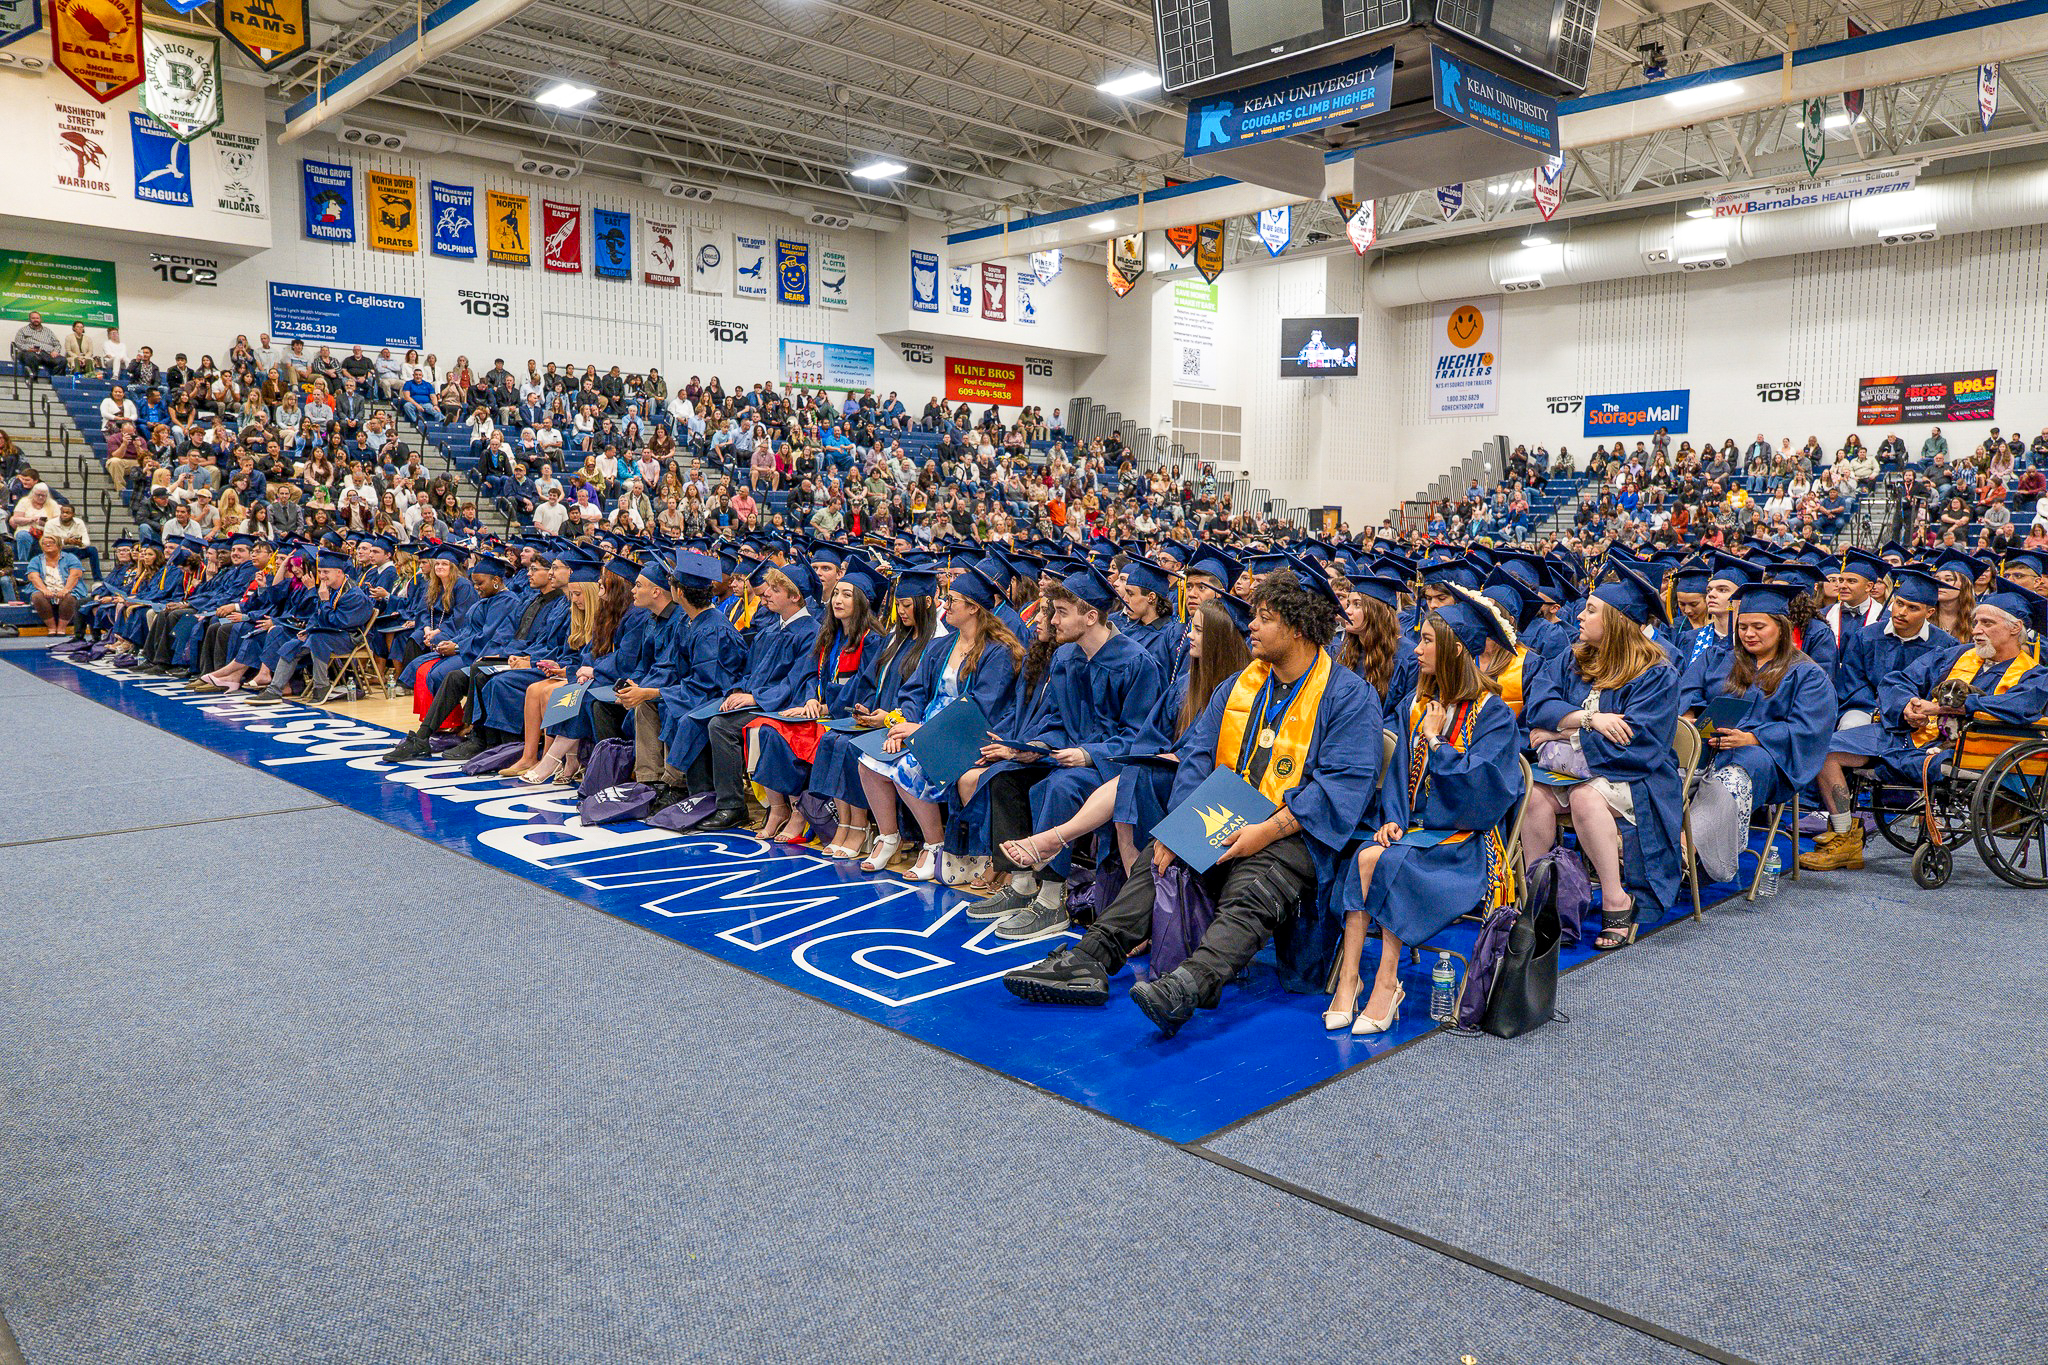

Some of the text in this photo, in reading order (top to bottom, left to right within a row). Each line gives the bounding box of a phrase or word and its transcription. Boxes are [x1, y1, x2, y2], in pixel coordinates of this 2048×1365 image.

[230, 11, 297, 35] RAMS
[62, 42, 135, 64] EAGLES
[73, 68, 128, 82] CONFERENCE
[86, 63, 114, 73] SHORE
[147, 44, 214, 98] RARITAN HIGH SCHOOL
[166, 59, 196, 91] R
[1242, 65, 1379, 114] KEAN UNIVERSITY
[1466, 77, 1549, 122] KEAN UNIVERSITY
[55, 103, 106, 120] WASHINGTON
[1241, 87, 1376, 131] COUGARS CLIMB HIGHER
[67, 114, 96, 127] STREET
[1467, 98, 1501, 122] COUGARS
[1501, 113, 1523, 131] CLIMB
[1523, 121, 1551, 140] HIGHER
[58, 122, 104, 136] ELEMENTARY
[211, 130, 260, 146] WALNUT STREET
[216, 140, 255, 151] ELEMENTARY
[305, 164, 351, 179] CEDAR GROVE
[57, 174, 111, 192] WARRIORS
[313, 175, 346, 187] ELEMENTARY
[371, 174, 414, 189] NORTH DOVER
[1774, 186, 1796, 195] TOMS
[1798, 182, 1822, 192] RIVER
[1865, 170, 1900, 181] SCHOOLS
[138, 186, 189, 203] SEAGULLS
[377, 186, 408, 195] ELEMENTARY
[1537, 184, 1558, 197] RAIDERS
[434, 191, 472, 206] NORTH
[496, 199, 523, 210] NORTH
[1715, 193, 1818, 218] RWJBarnabas
[1822, 189, 1863, 201] HEALTH
[1864, 181, 1911, 196] ARENA
[218, 198, 260, 214] WILDCATS
[552, 210, 571, 219] EAST
[604, 217, 622, 226] EAST
[311, 224, 352, 239] PATRIOTS
[651, 226, 673, 235] SOUTH
[377, 236, 413, 248] PIRATES
[437, 241, 474, 254] DOLPHINS
[737, 236, 766, 246] WEST DOVER
[150, 252, 218, 268] SECTION
[492, 252, 528, 263] MARINERS
[822, 251, 845, 261] JOSEPH
[8, 258, 102, 273] FERTILIZER PROGRAMS
[547, 258, 580, 270] ROCKETS
[24, 271, 88, 283] WEED CONTROL
[152, 263, 218, 287] 102
[650, 274, 675, 284] INDIANS
[15, 281, 56, 290] AERATION
[64, 286, 99, 295] SEEDING
[738, 285, 767, 295] BLUE JAYS
[2, 291, 47, 301] MOSQUITO
[74, 299, 112, 307] CONTROL
[273, 285, 405, 310] Lawrence P. Cagliostro
[457, 289, 510, 302] SECTION
[784, 291, 805, 302] BEARS
[460, 299, 510, 318] 103
[952, 305, 969, 314] BEARS
[274, 320, 338, 334] 732.286.3128
[708, 319, 749, 330] SECTION
[709, 328, 749, 344] 104
[795, 345, 816, 357] Lice
[901, 342, 934, 350] SECTION
[787, 354, 823, 369] Lifters
[902, 350, 933, 364] 105
[1025, 357, 1053, 365] SECTION
[1437, 352, 1486, 370] HECHT
[954, 364, 1016, 380] KLINE BROS
[1025, 364, 1053, 376] 106
[1435, 366, 1492, 379] TRAILERS
[963, 377, 1006, 389] Pool Company
[1756, 381, 1802, 390] SECTION
[1953, 376, 1995, 395] B98.5
[958, 388, 1012, 400] 609-494-5838
[1757, 389, 1801, 403] 108
[1861, 388, 1900, 396] THUNDER
[1910, 386, 1948, 397] BOSS
[1546, 395, 1584, 403] SECTION
[1547, 402, 1582, 414] 107
[1602, 403, 1620, 413] The
[1208, 815, 1245, 846] OCEAN
